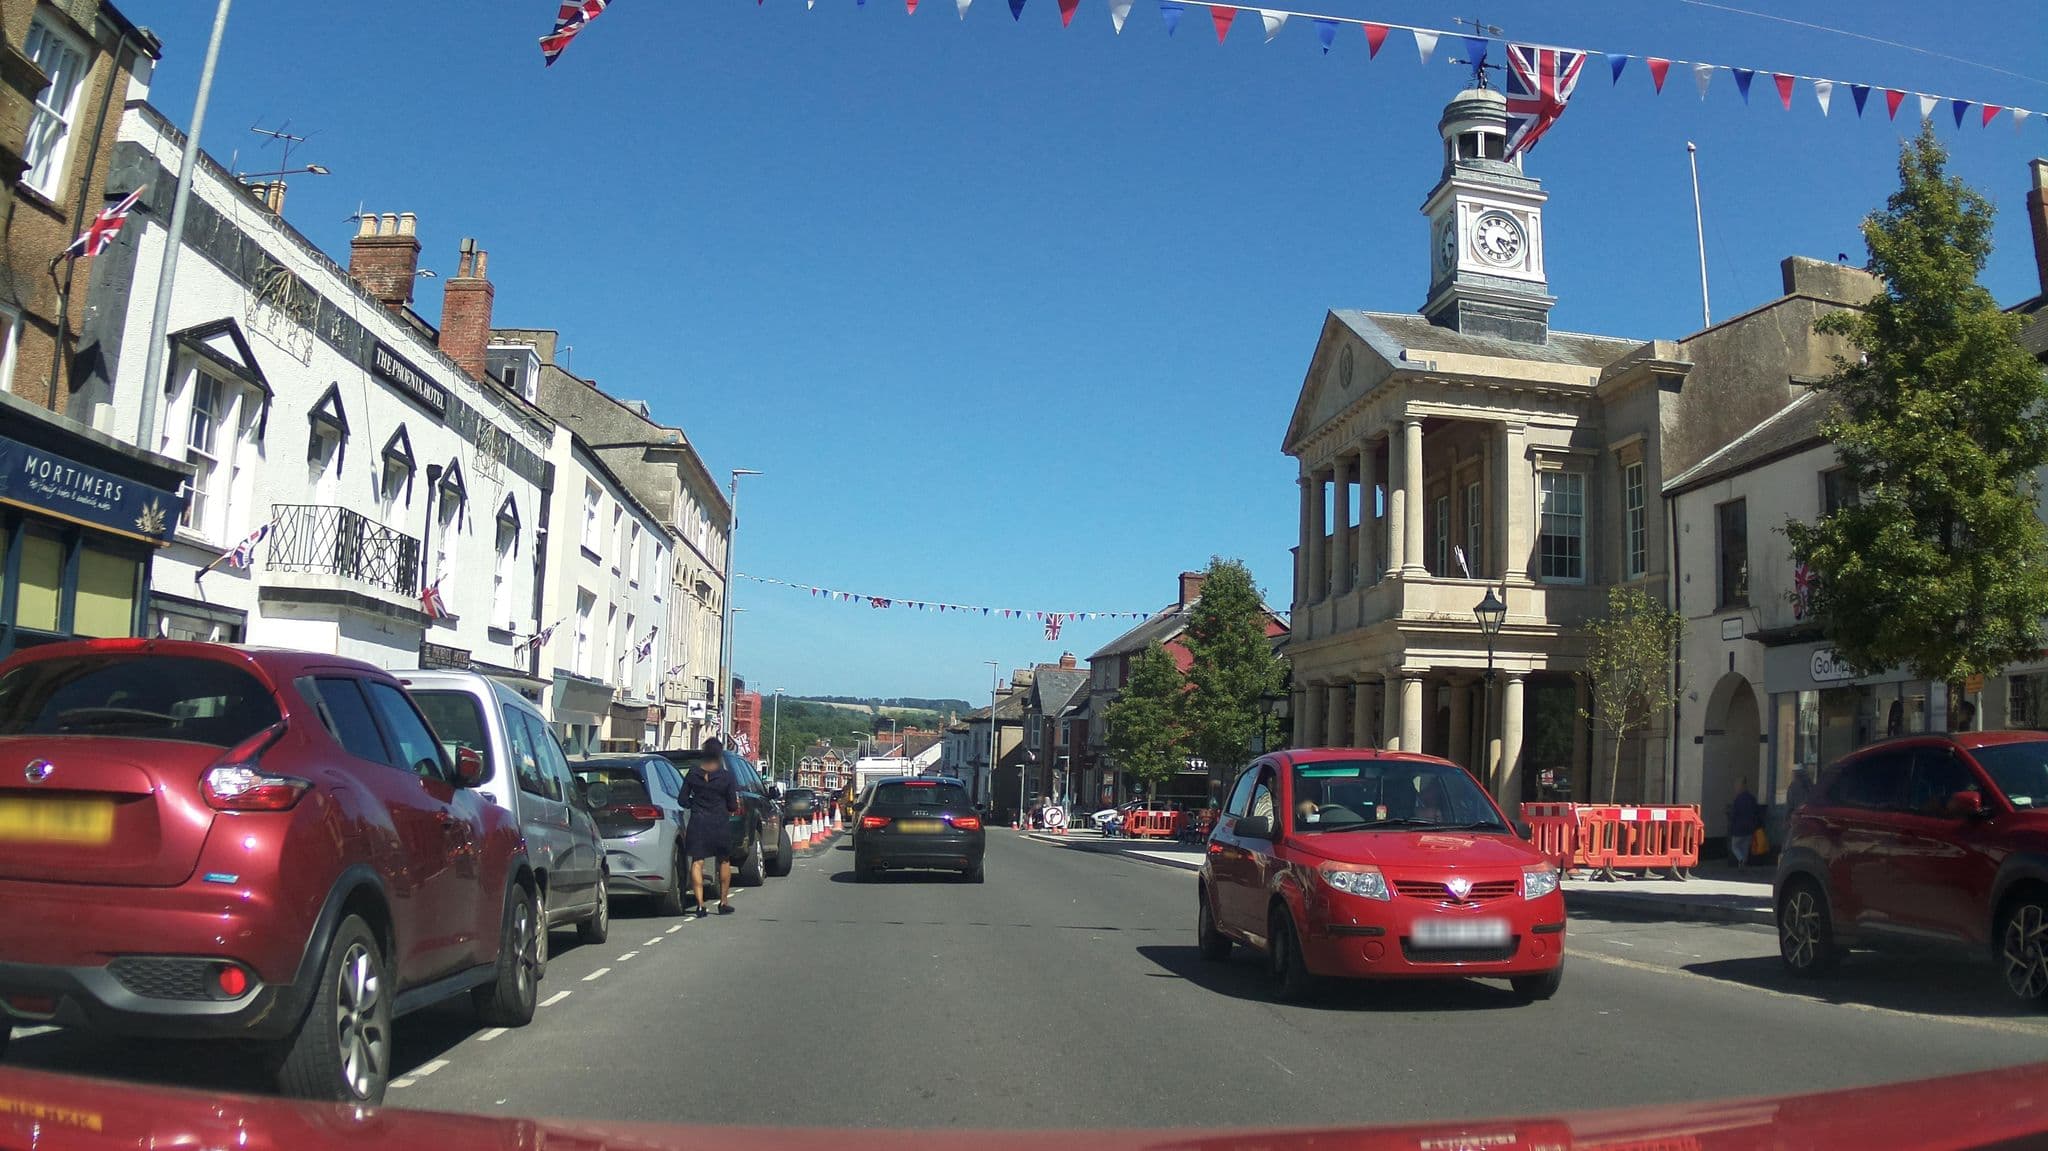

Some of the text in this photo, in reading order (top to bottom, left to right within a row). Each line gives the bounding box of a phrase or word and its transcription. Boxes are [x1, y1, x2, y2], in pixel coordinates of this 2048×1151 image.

[376, 347, 445, 410] THE PHOENIX HOTEL
[25, 455, 123, 501] MORTIMERS
